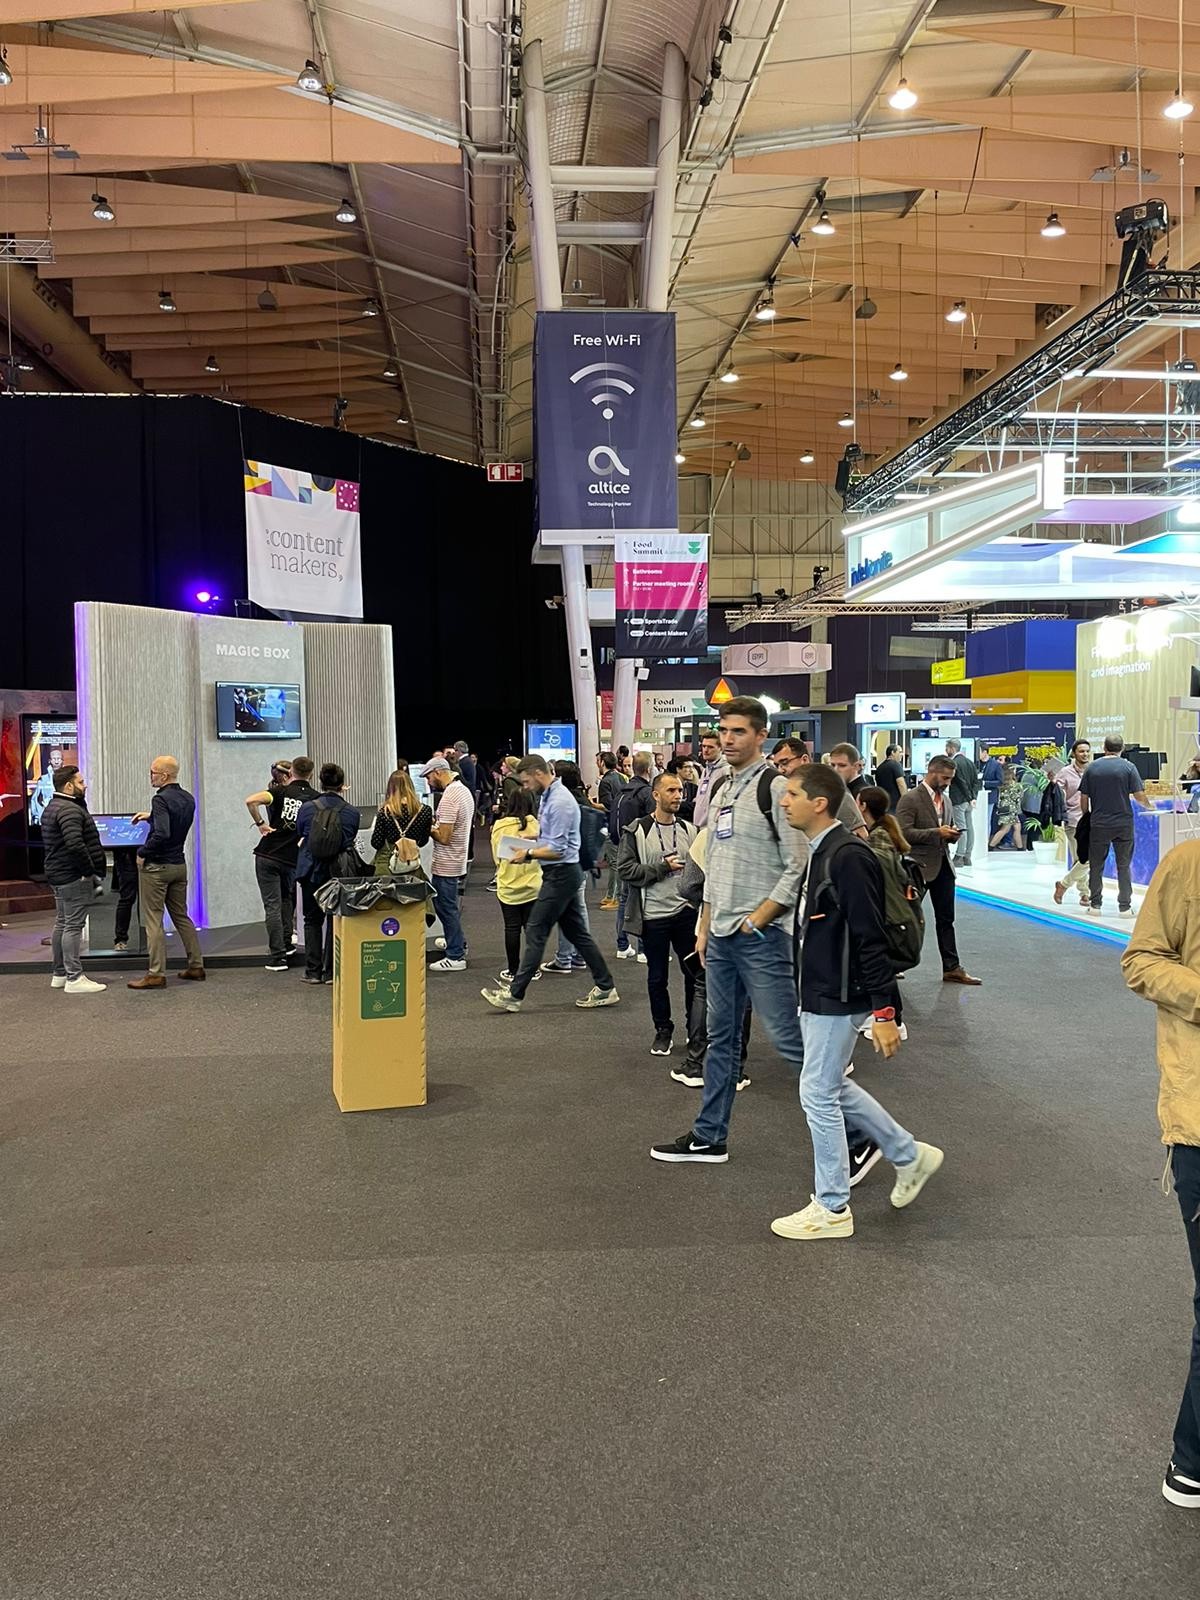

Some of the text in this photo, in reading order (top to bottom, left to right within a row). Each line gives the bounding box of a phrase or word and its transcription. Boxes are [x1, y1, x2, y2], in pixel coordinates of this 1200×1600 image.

[573, 334, 641, 346] Free Wi-Fi
[588, 481, 631, 494] altice
[270, 551, 344, 582] makers,
[216, 643, 291, 660] MAGIC BOX
[1105, 661, 1151, 677] imagination
[652, 705, 687, 713] Summit
[283, 797, 303, 809] FOR
